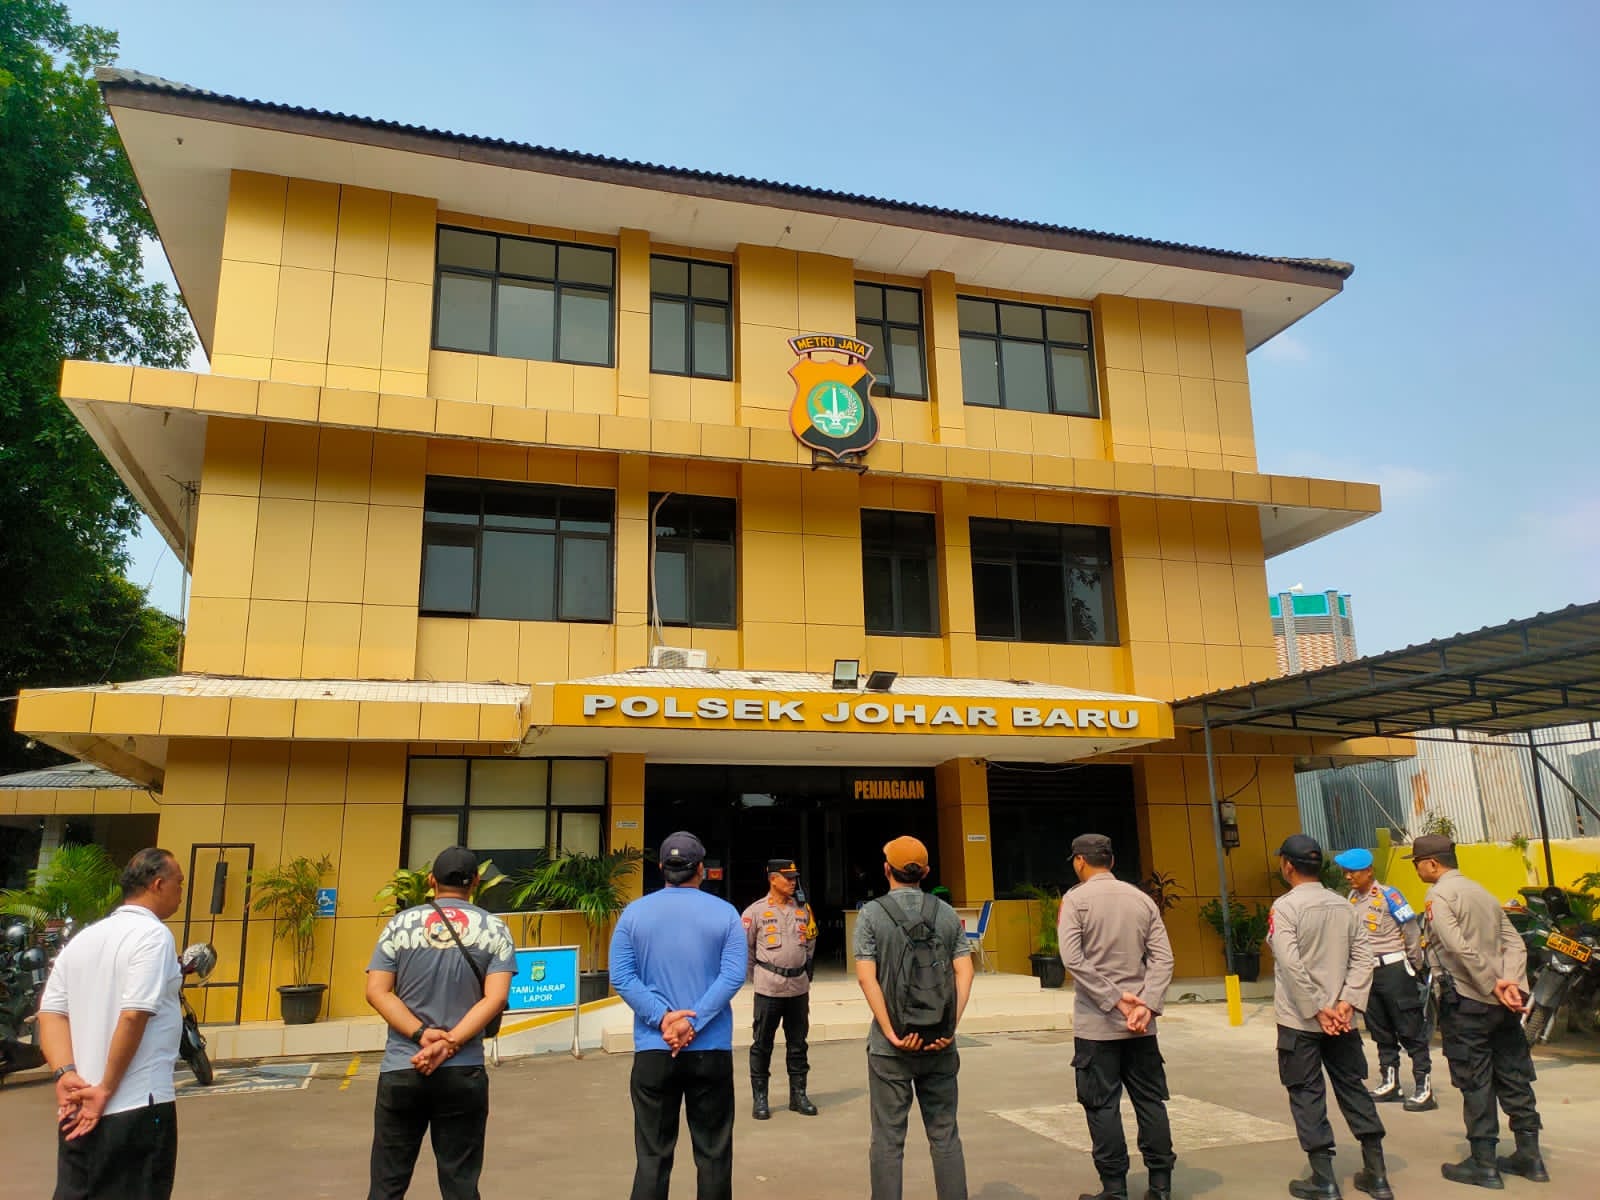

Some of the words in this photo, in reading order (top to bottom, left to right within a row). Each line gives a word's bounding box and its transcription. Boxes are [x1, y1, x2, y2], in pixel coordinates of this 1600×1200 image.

[797, 336, 835, 350] METRO
[838, 339, 865, 355] JAYA
[583, 694, 804, 721] POLSEK
[821, 701, 998, 726] JOHAR
[1012, 706, 1139, 729] BARU
[854, 780, 925, 800] PENJAGAAN
[512, 984, 535, 994] TAMU
[536, 983, 566, 993] HARAP
[523, 993, 553, 1003] LAPOR
